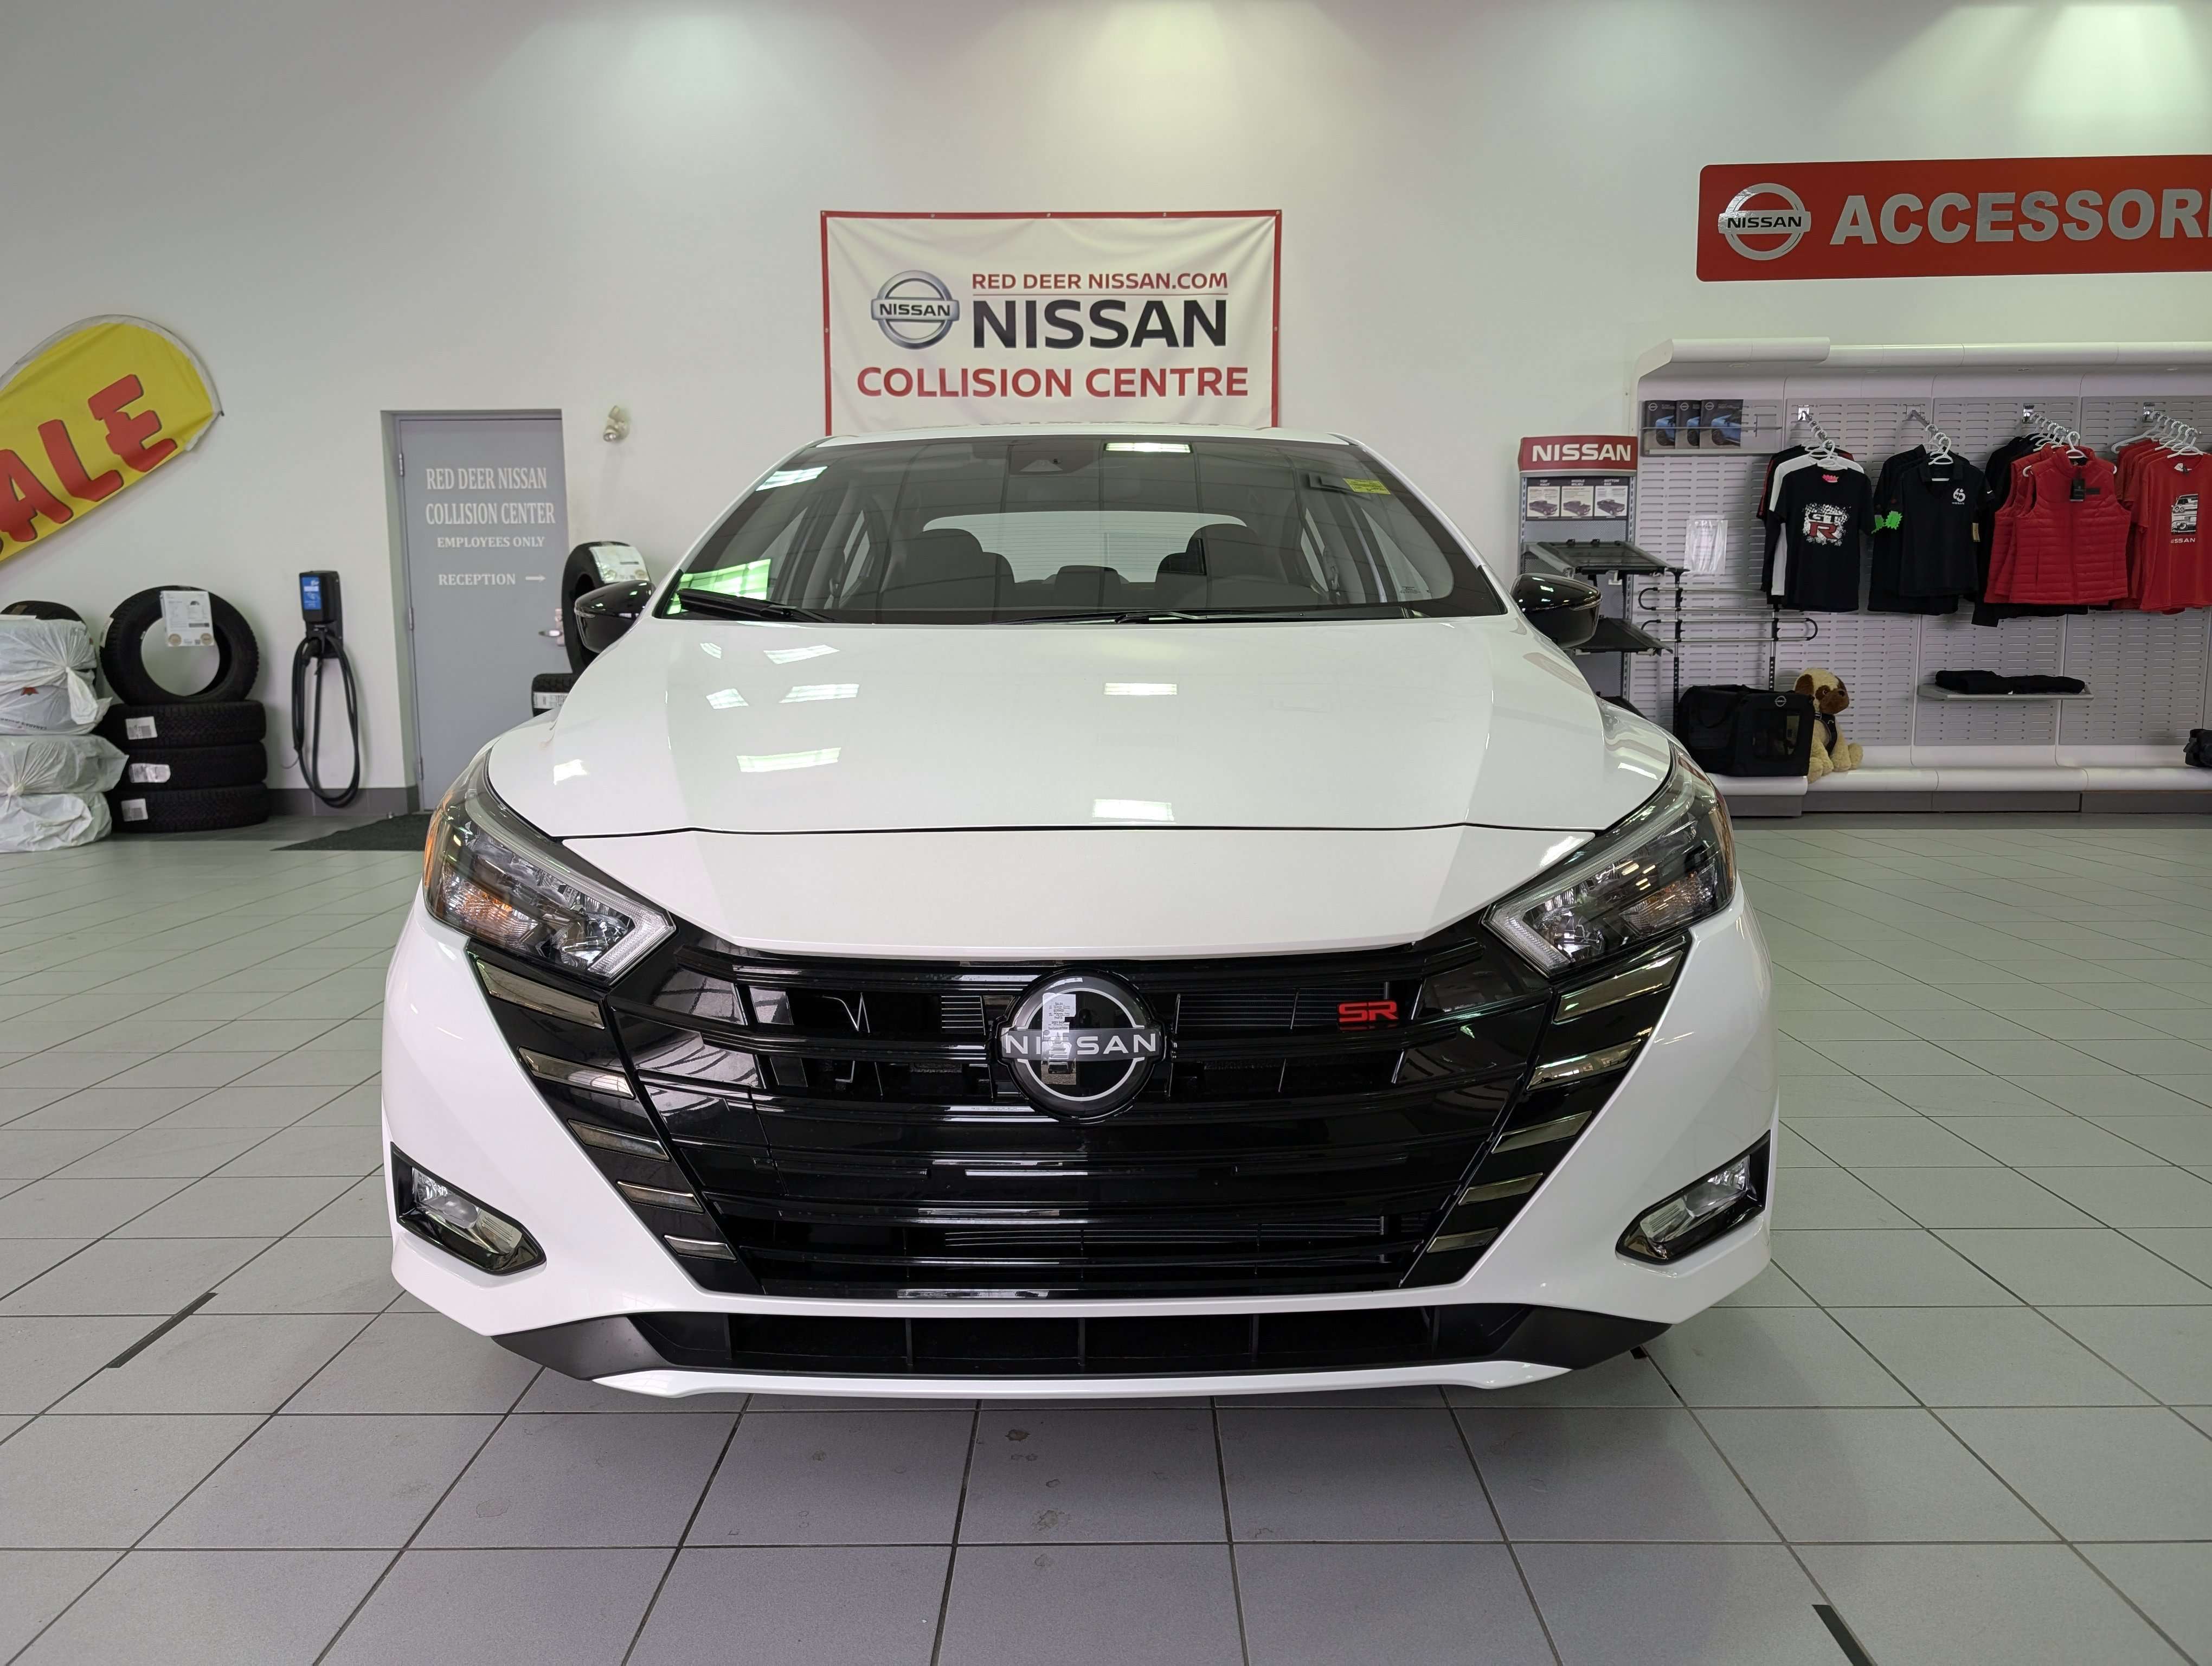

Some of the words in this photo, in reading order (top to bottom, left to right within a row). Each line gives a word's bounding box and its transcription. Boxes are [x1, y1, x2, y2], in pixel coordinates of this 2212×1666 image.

[1727, 216, 1802, 229] NISSAN
[973, 273, 1016, 289] RED
[1023, 273, 1081, 289] DEER
[1088, 272, 1228, 289] NISSAN.COM
[879, 304, 950, 317] NISSAN
[973, 299, 1227, 348] NISSAN
[857, 367, 1072, 398] COLLISION
[1085, 367, 1249, 398] CENTRE
[1532, 444, 1631, 462] NISSAN
[0, 374, 178, 554] ALE
[426, 469, 454, 490] RED
[458, 468, 495, 490] DEER
[498, 467, 546, 489] NISSAN
[426, 503, 498, 524] COLLISION
[501, 503, 556, 524] CENTER
[437, 537, 510, 548] EMPLOYEES
[513, 536, 545, 547] ONLY
[438, 574, 516, 586] RECEPTION
[1339, 1001, 1398, 1023] SR
